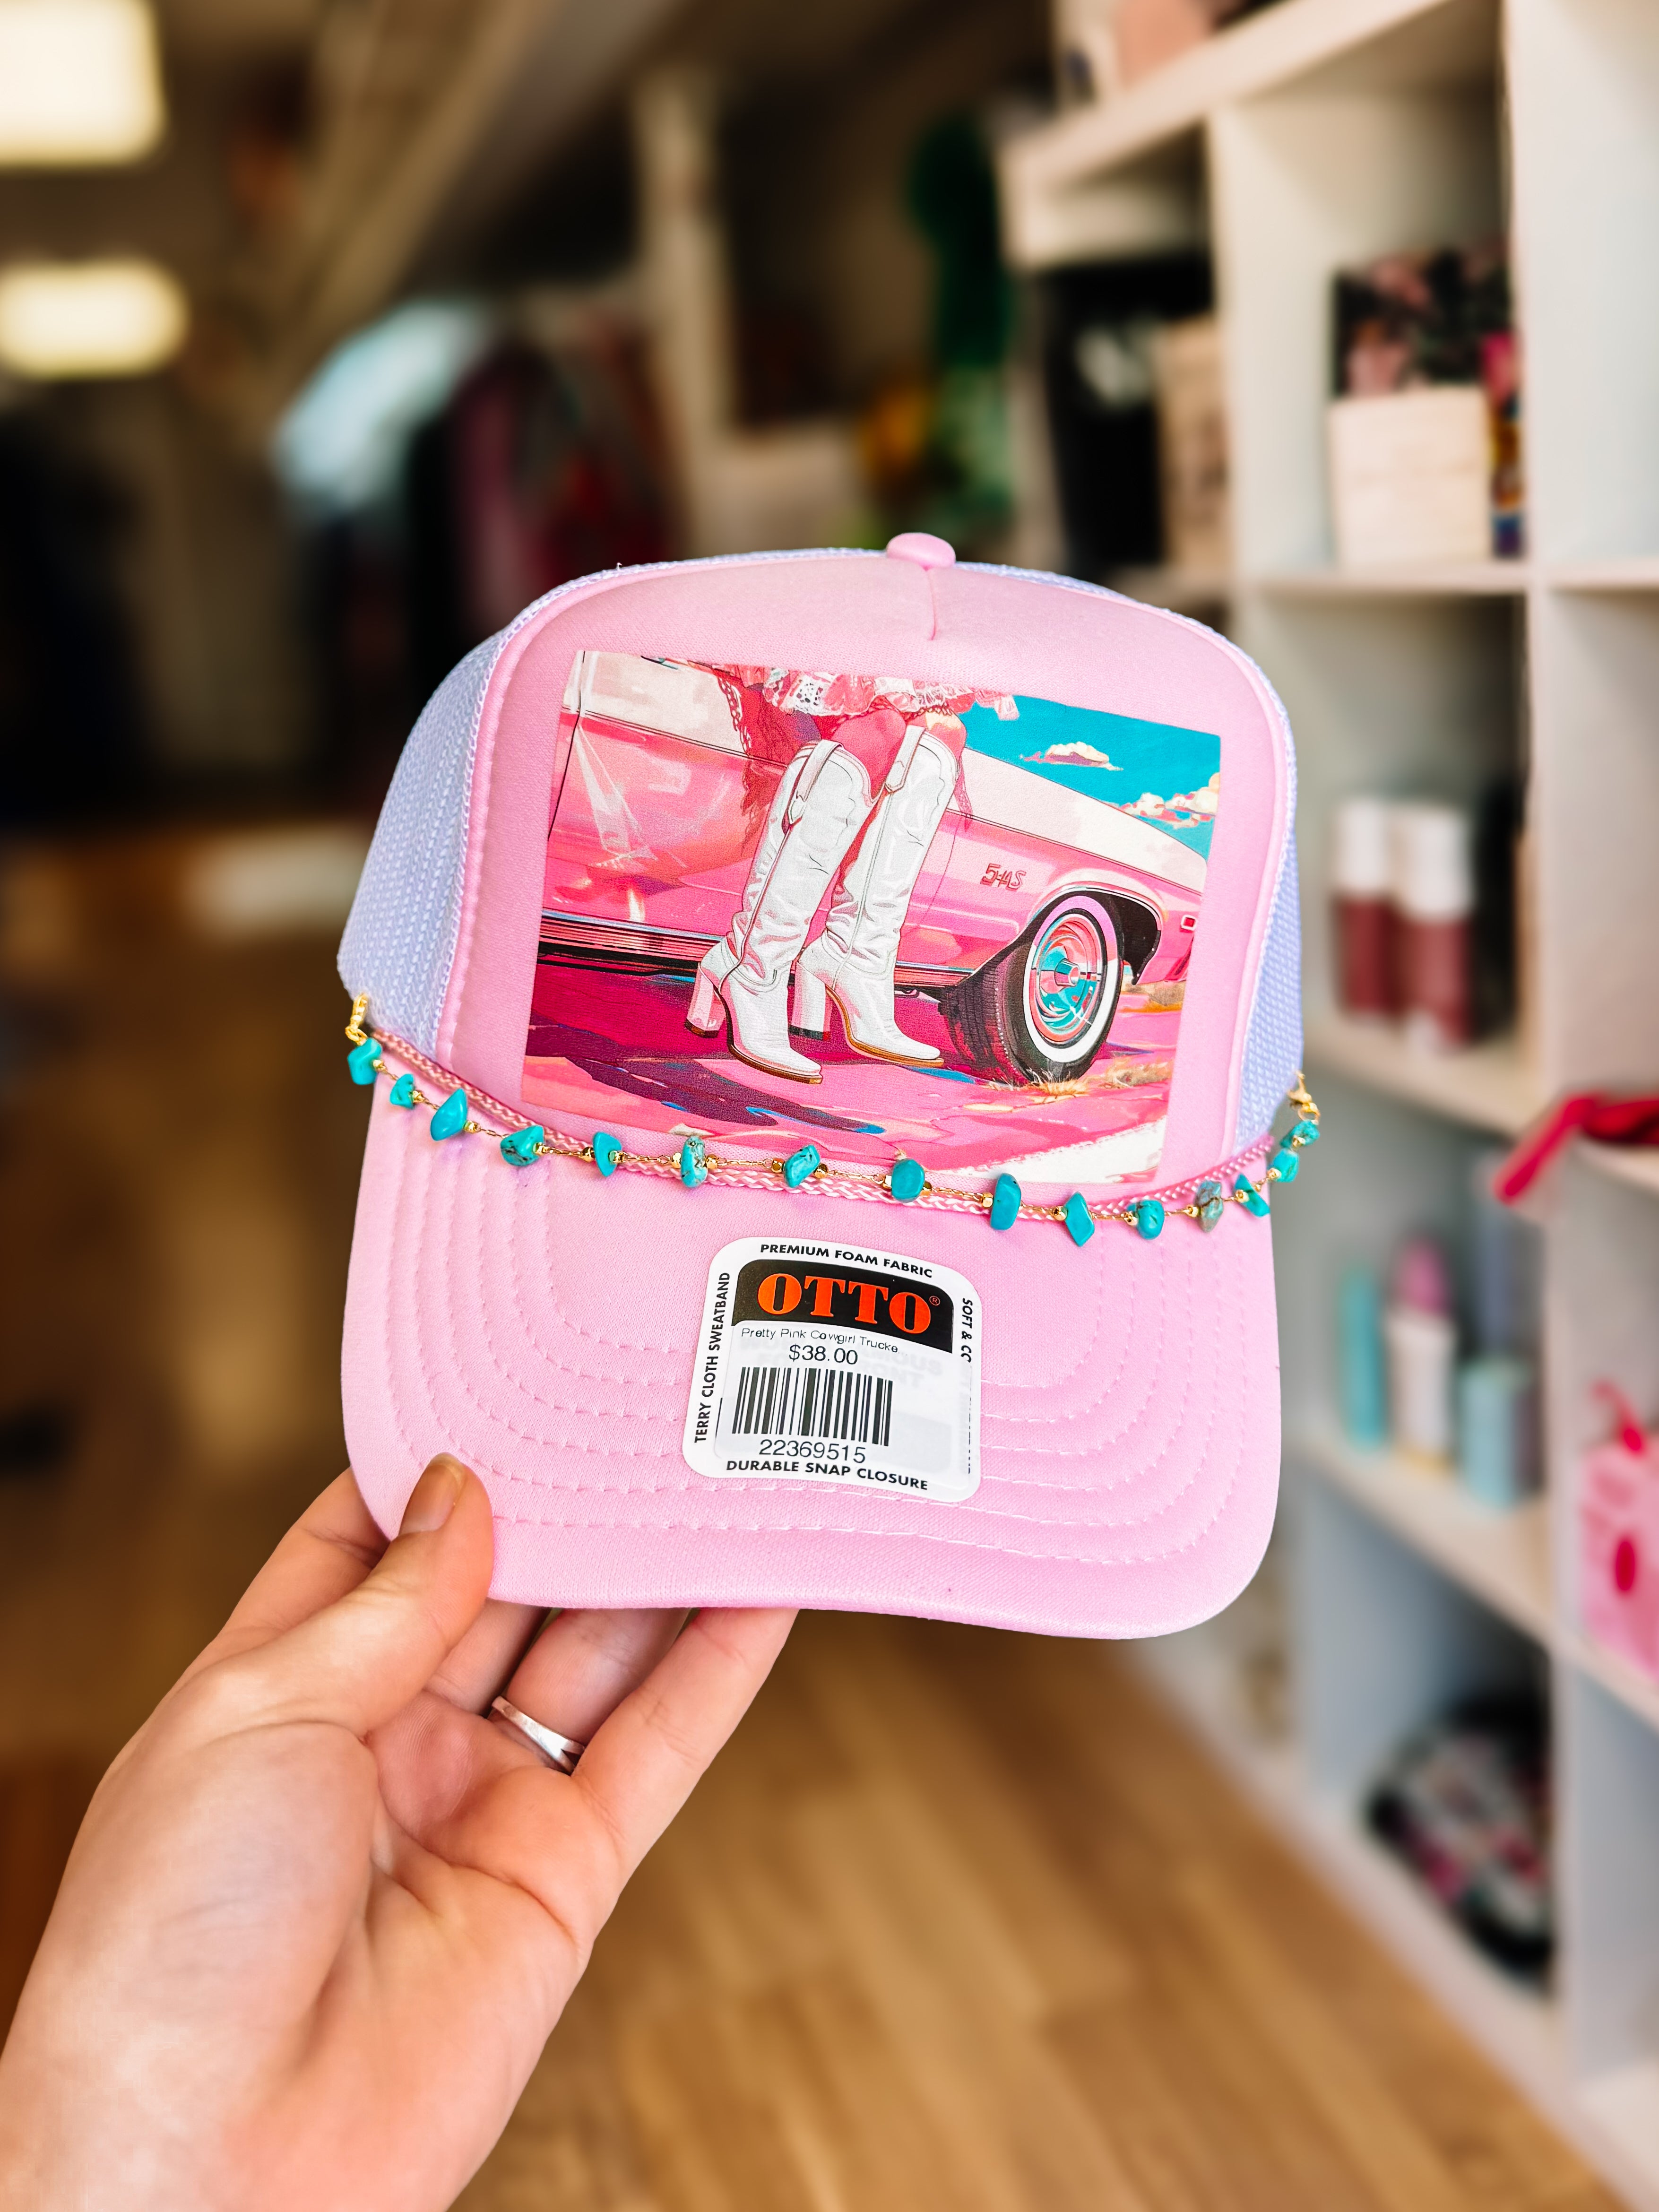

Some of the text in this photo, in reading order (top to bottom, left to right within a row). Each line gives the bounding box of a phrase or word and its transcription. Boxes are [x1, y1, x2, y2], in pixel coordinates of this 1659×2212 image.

[760, 1244, 933, 1278] PREMIUM FOAM FABRIC
[962, 1297, 973, 1329] SOFT
[741, 1328, 776, 1340] Pretty
[781, 1329, 806, 1338] Pink
[811, 1330, 855, 1344] Cowgirl
[961, 1331, 972, 1340] &
[694, 1272, 730, 1443] TERRY CLOTH SWEATBAND
[789, 1343, 858, 1365] $38.00
[759, 1439, 866, 1464] 22369515
[726, 1460, 928, 1490] DURABLE SNAP CLOSURE
